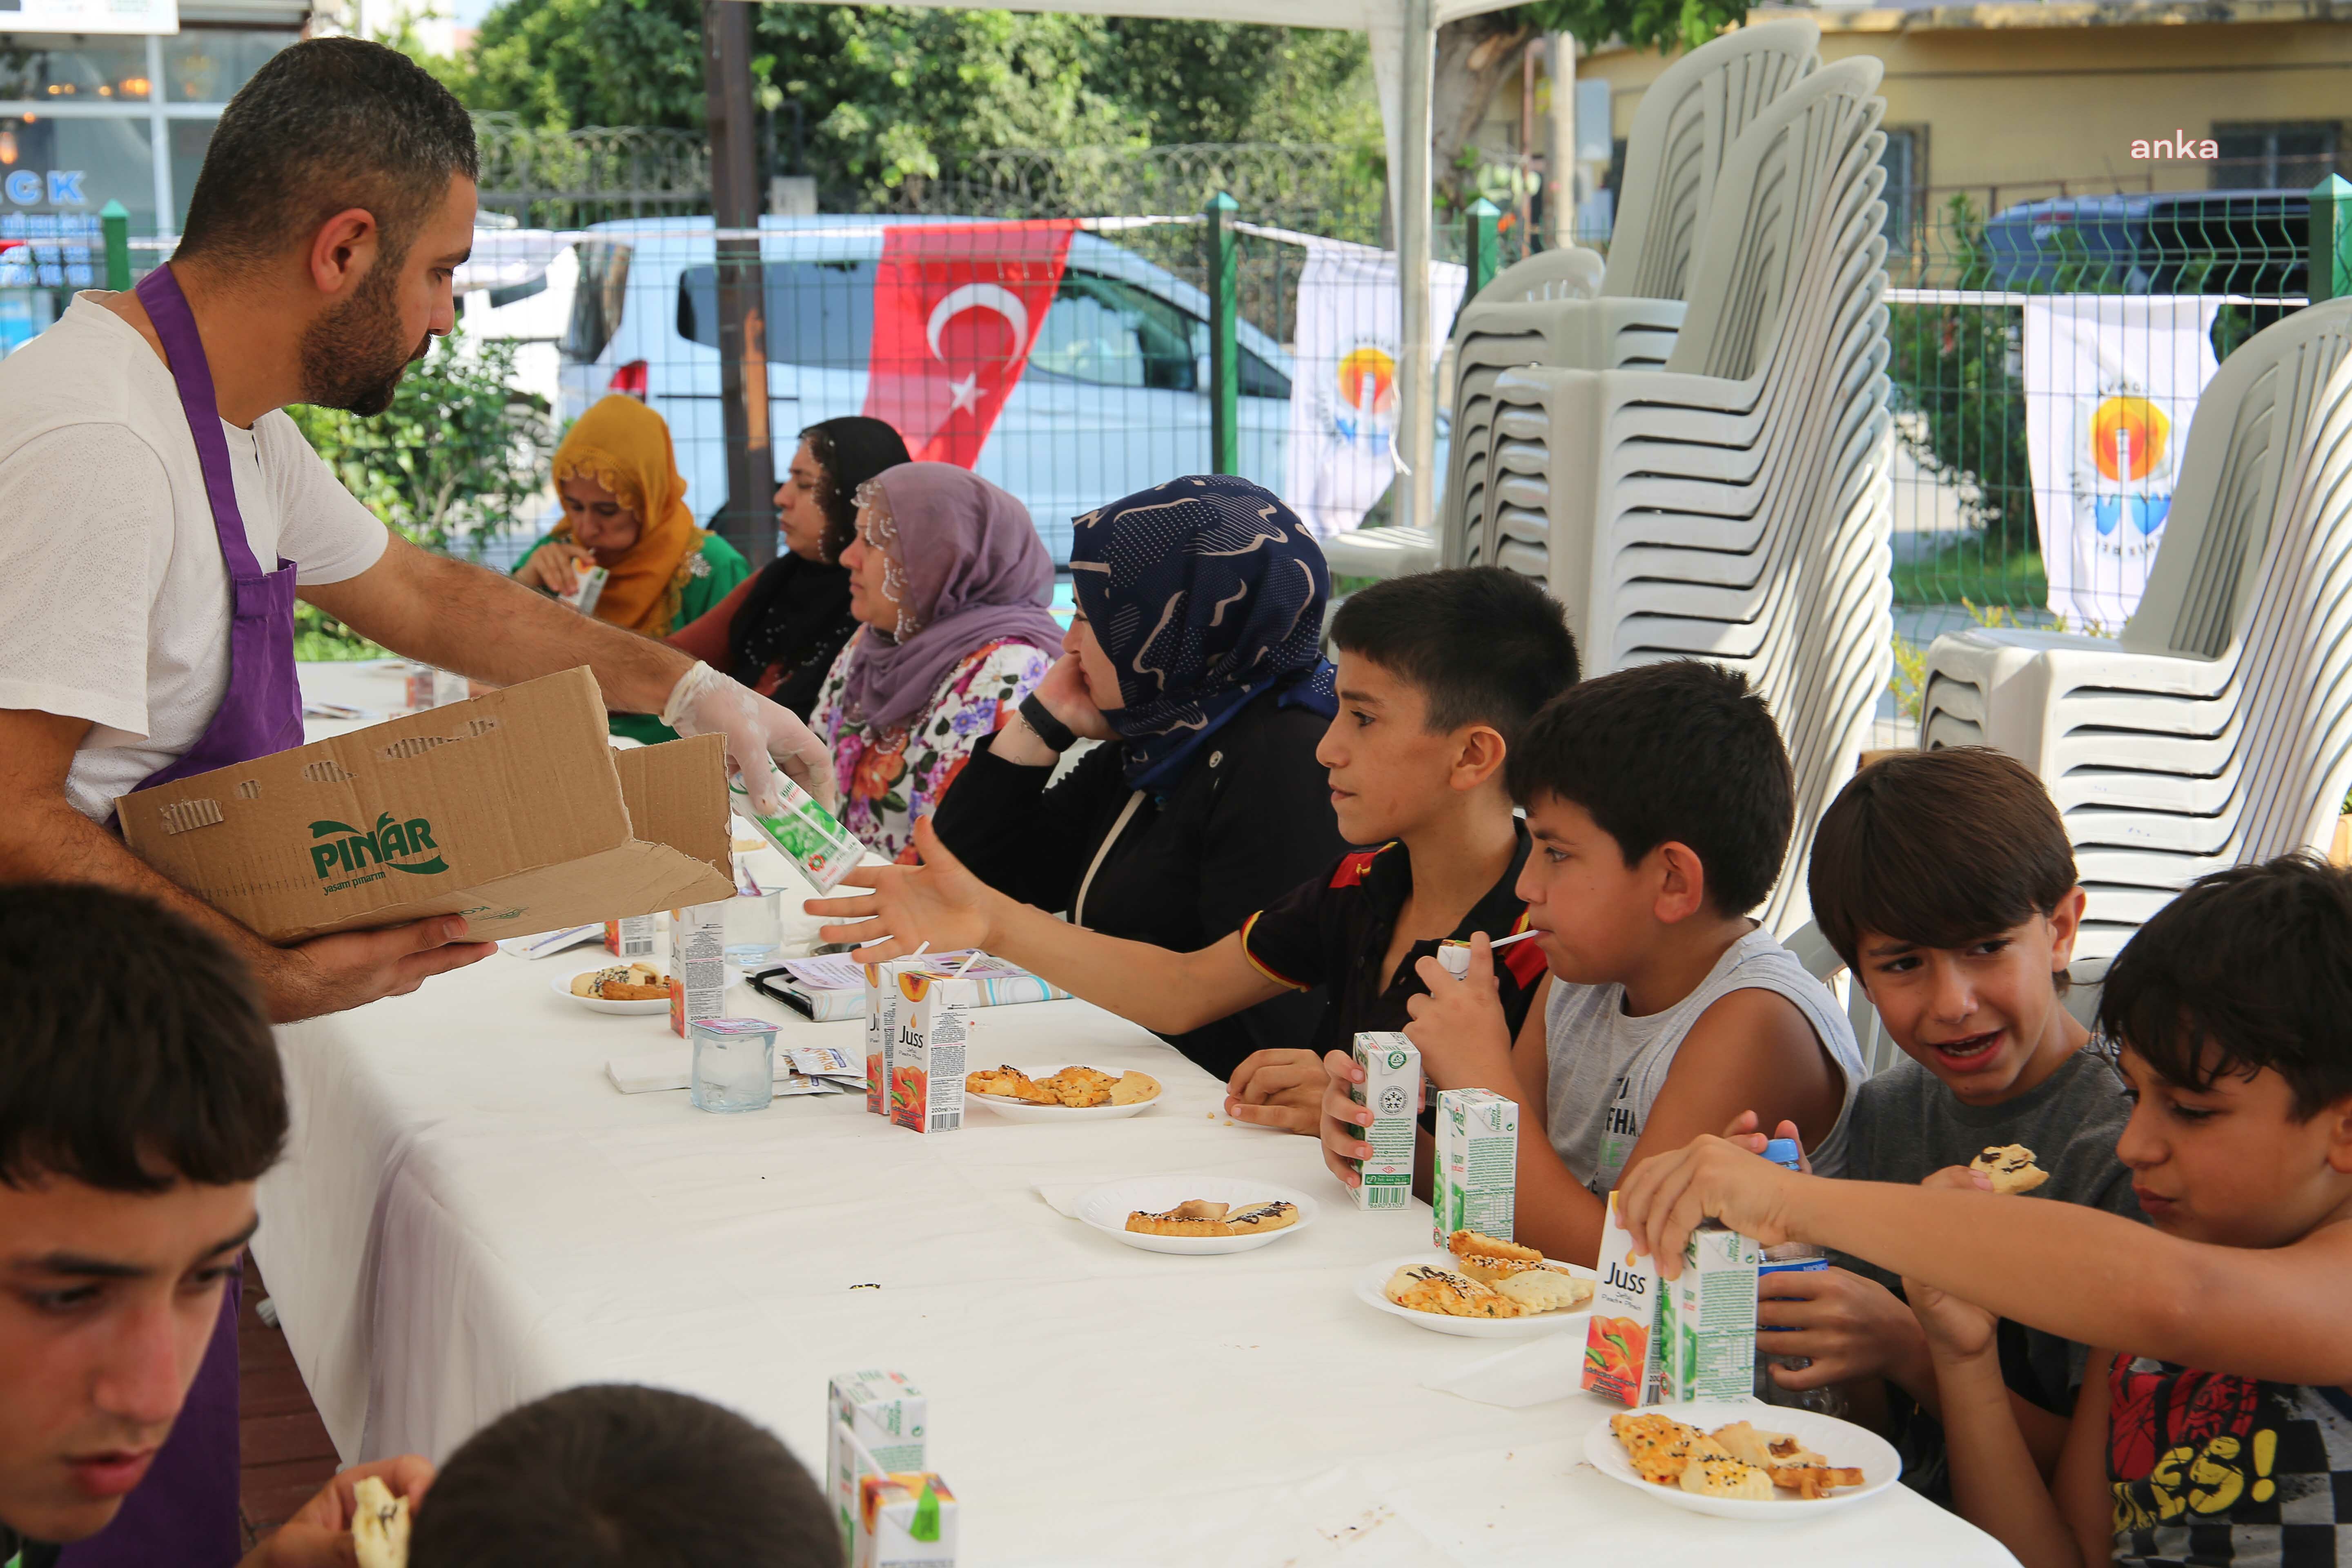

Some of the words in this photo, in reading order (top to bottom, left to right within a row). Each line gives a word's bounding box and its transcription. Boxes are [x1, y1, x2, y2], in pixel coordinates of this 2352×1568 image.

[0, 169, 86, 205] CK
[310, 818, 438, 879] PINAR
[899, 1025, 923, 1048] Juss
[1604, 1261, 1645, 1294] Juss
